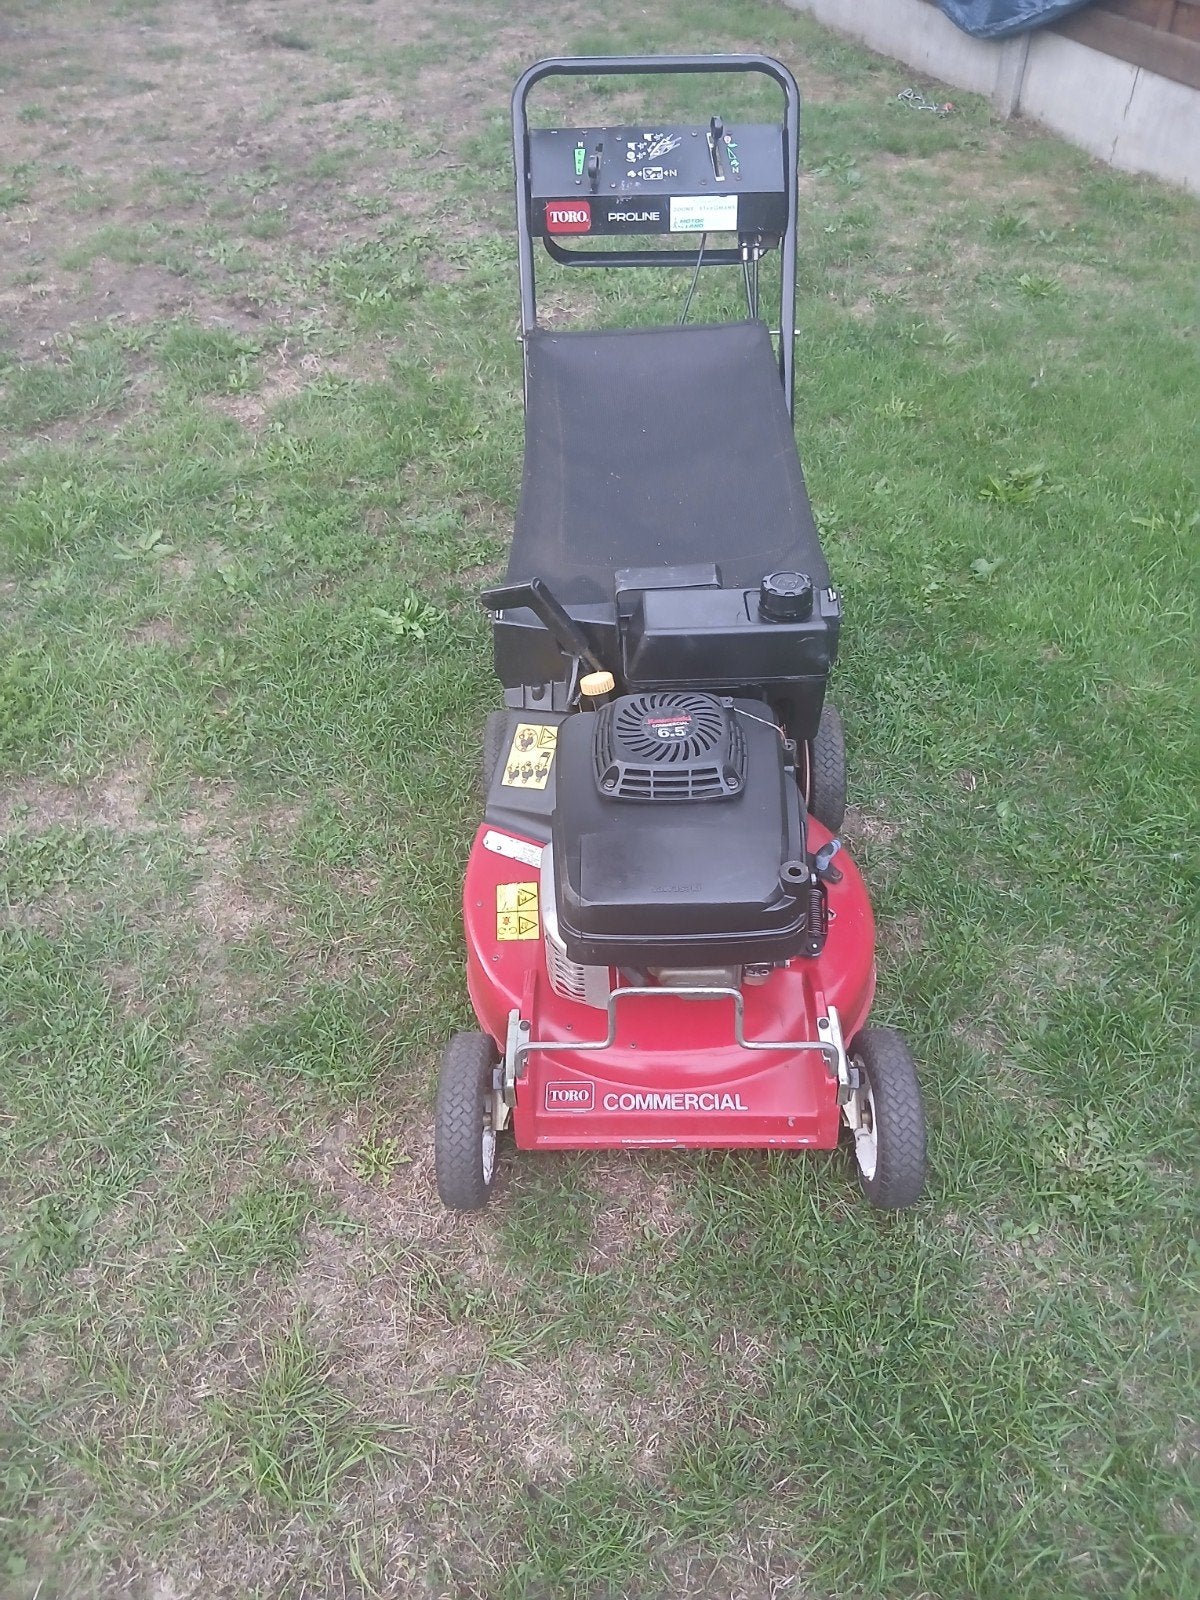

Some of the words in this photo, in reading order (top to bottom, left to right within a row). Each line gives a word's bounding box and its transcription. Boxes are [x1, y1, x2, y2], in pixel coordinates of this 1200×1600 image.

[669, 169, 678, 177] N
[550, 211, 588, 223] TORO
[608, 211, 660, 222] PROLINE
[658, 726, 687, 738] 6.5
[550, 1089, 590, 1103] TORO
[603, 1093, 749, 1111] COMMERCIAL
